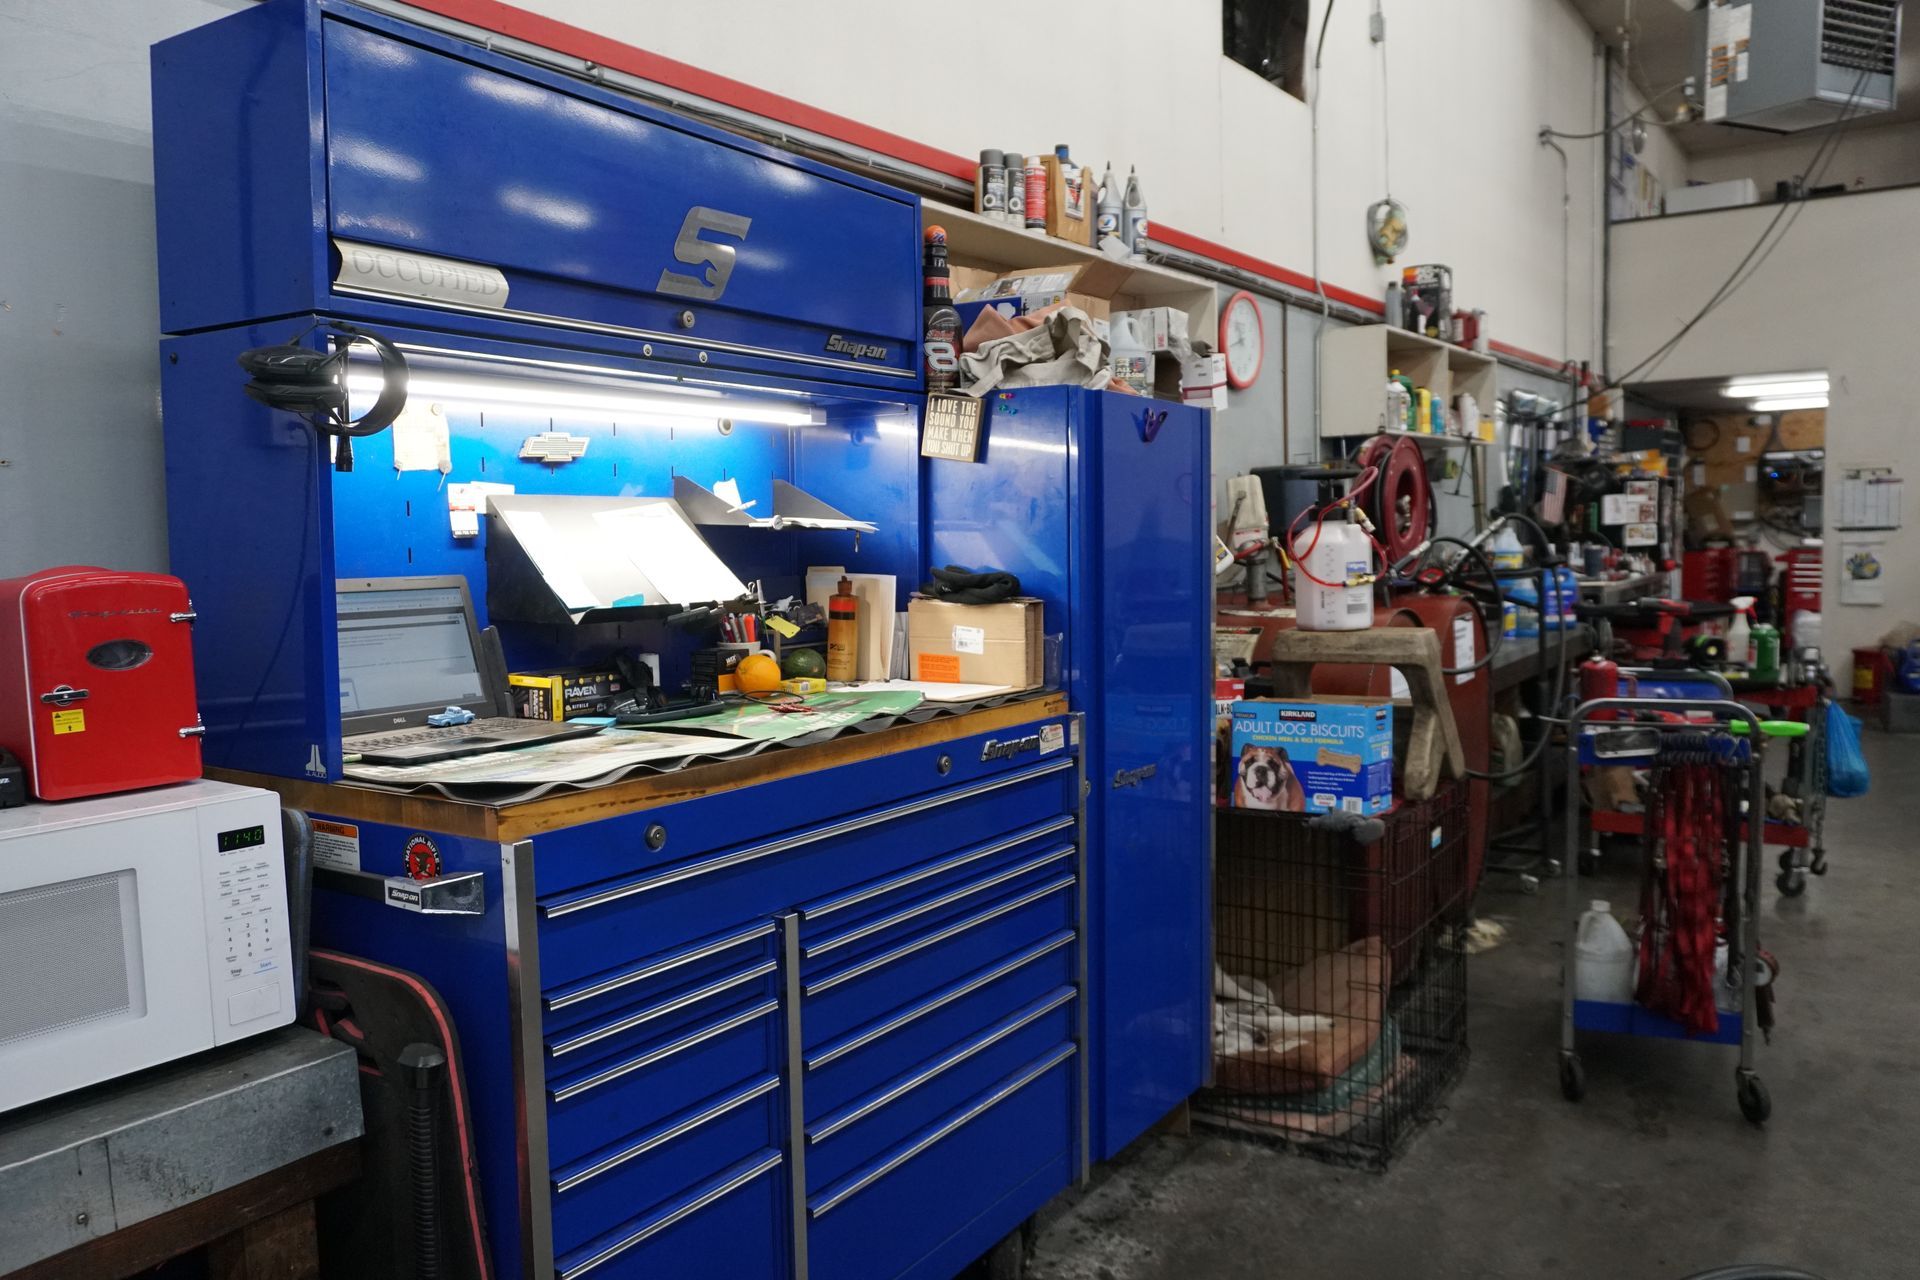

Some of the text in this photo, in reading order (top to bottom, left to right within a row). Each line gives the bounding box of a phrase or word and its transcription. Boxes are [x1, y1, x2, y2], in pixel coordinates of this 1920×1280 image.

[352, 250, 500, 296] OCCUPIED
[827, 334, 888, 360] Snap-on
[924, 341, 958, 372] 8
[930, 397, 977, 416] I LOVE THE
[928, 411, 976, 430] SOUND YOU
[927, 425, 974, 443] MAKE WHEN
[926, 439, 972, 457] YOU SHUT UP
[564, 684, 598, 699] RAVEN
[1280, 710, 1316, 718] KIRKLAND
[1234, 720, 1365, 738] ADULT DOG BISCUITS
[405, 836, 440, 864] NATIONAL RIFLE
[391, 889, 419, 902] Snap-on
